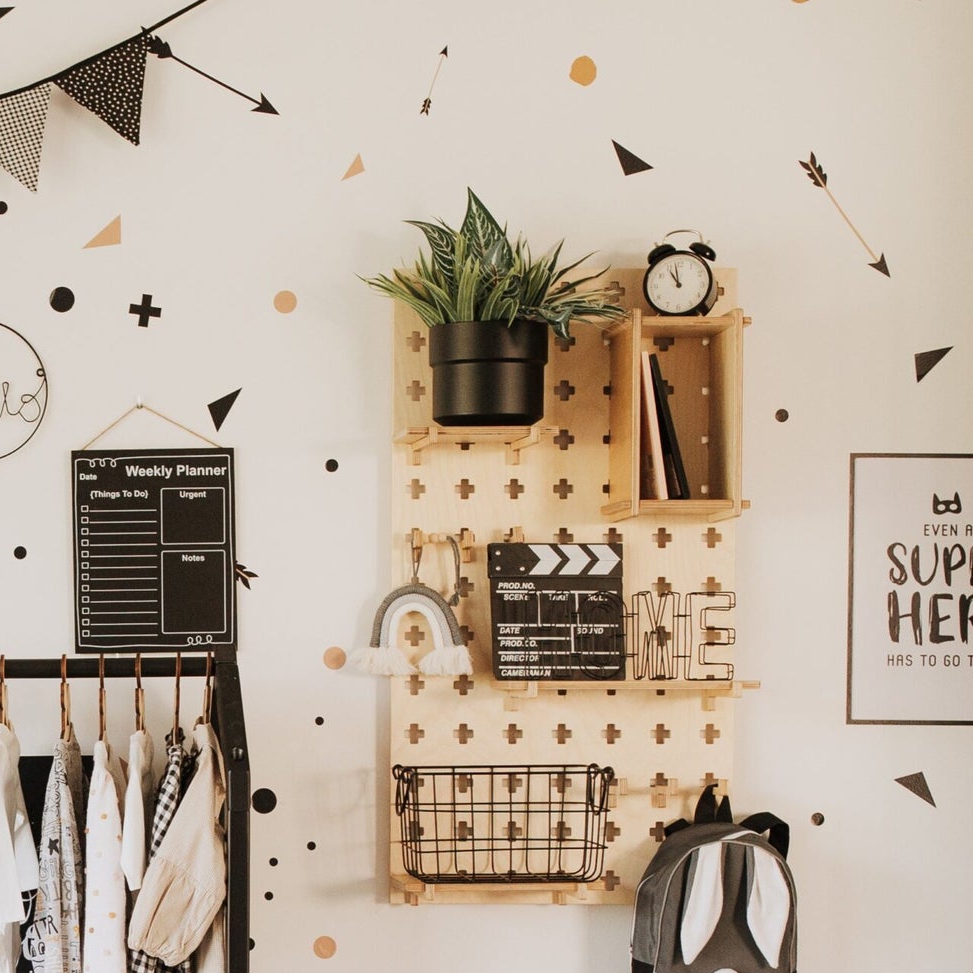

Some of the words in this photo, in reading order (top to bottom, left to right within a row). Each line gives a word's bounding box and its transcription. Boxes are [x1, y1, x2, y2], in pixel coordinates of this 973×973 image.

[125, 465, 173, 479] Weekly
[177, 464, 227, 476] Planner
[79, 473, 98, 481] Date
[122, 490, 132, 498] To
[179, 490, 207, 500] Urgent
[923, 524, 959, 537] EVEN
[965, 524, 973, 537] A
[181, 554, 205, 562] Notes
[886, 542, 973, 587] SUP
[498, 582, 536, 590] PROD.NO.
[887, 654, 913, 667] HAS
[920, 654, 937, 667] TO
[943, 654, 961, 667] GO
